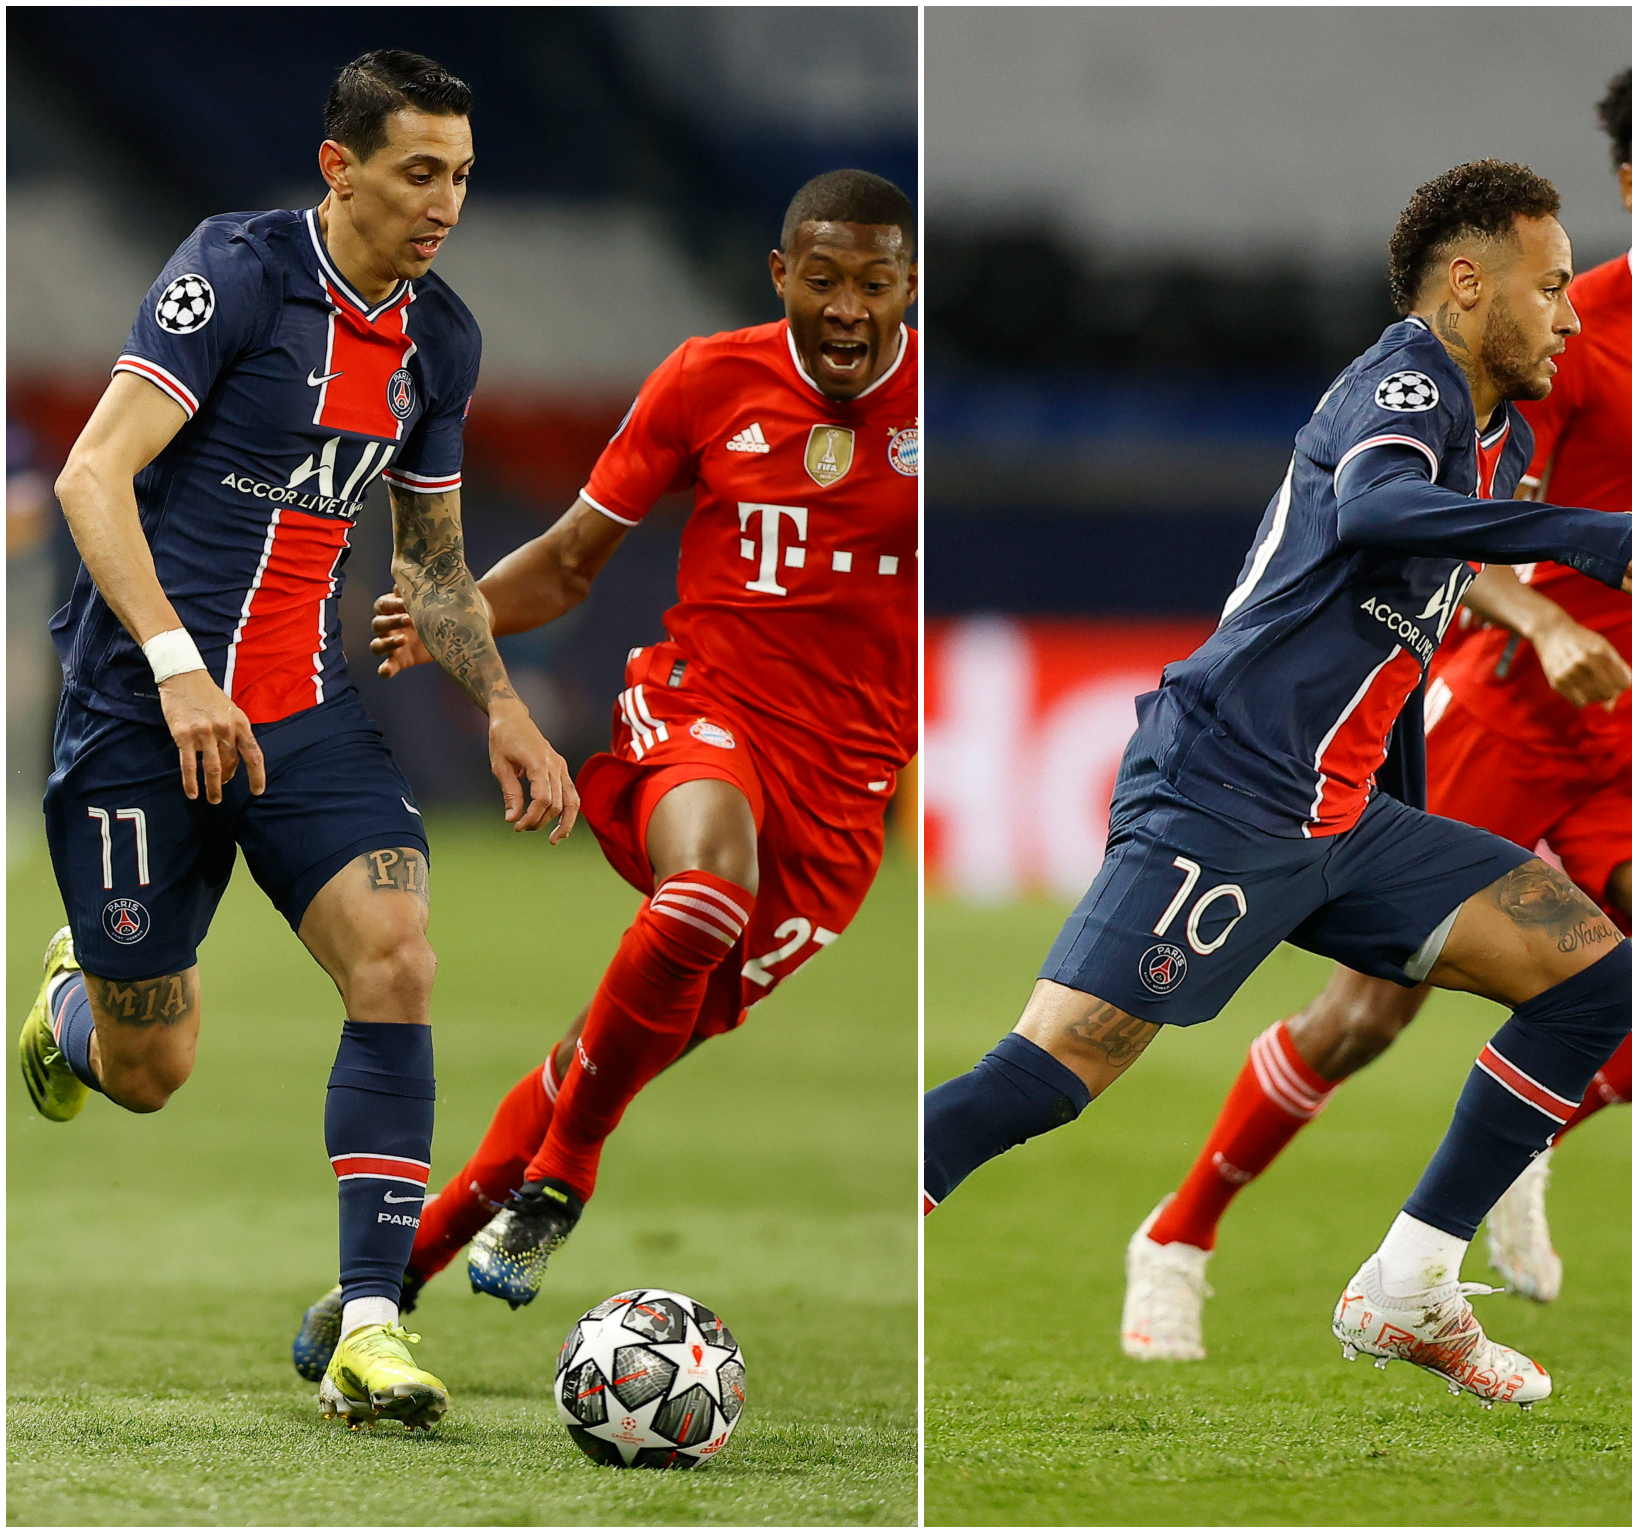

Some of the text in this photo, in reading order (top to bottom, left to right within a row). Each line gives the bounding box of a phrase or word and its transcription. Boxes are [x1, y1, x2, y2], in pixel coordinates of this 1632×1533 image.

[817, 462, 838, 472] FIFA
[220, 472, 298, 504] ACCOR
[298, 493, 341, 515] LIVE
[1360, 596, 1420, 647] ACCOR
[88, 806, 150, 890] 11
[107, 900, 139, 913] PARIS
[1151, 855, 1248, 956] 10
[1156, 946, 1185, 967] PARIS
[105, 975, 188, 1021] MIA
[377, 1211, 421, 1230] PARIS
